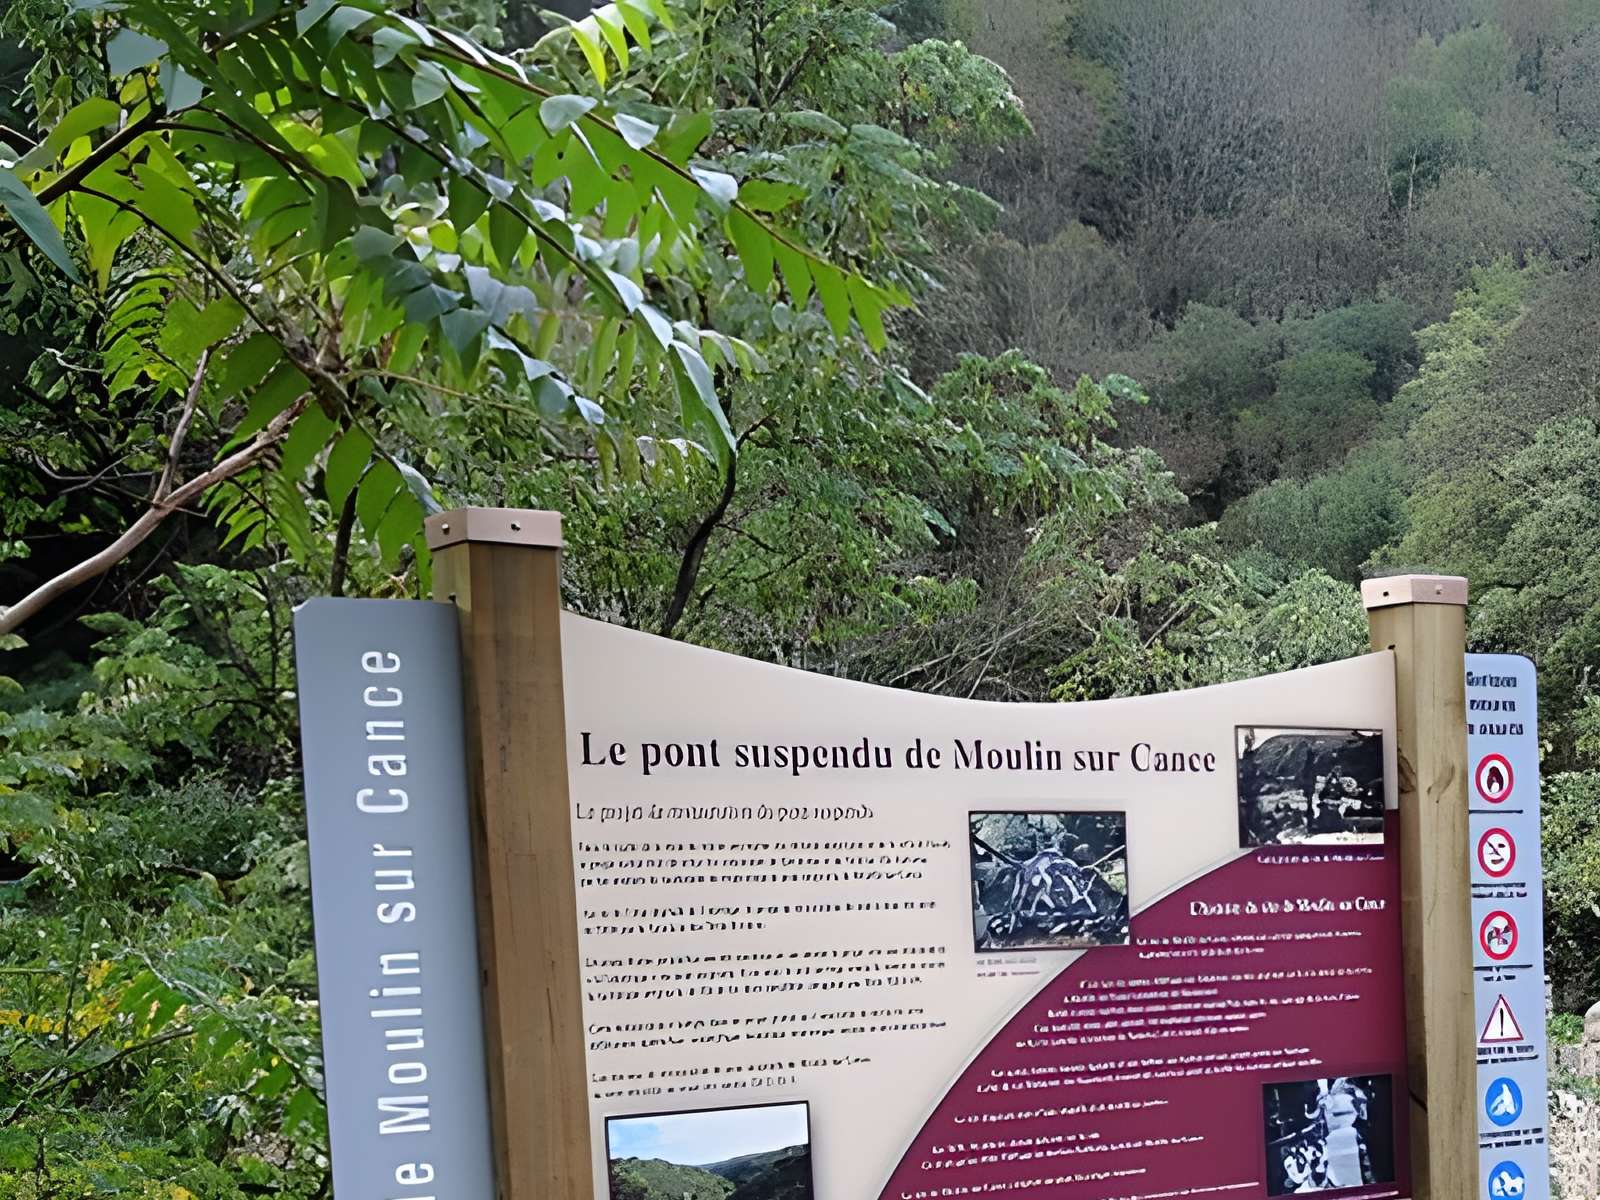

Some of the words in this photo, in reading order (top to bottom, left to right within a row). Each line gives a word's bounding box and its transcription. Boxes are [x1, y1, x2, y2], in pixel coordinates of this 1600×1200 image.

[356, 650, 409, 815] Cance
[580, 731, 626, 766] Le
[641, 738, 721, 776] pont
[734, 736, 892, 777] suspendu
[905, 737, 942, 769] de
[953, 738, 1062, 771] Moulin
[1073, 750, 1121, 772] sur
[1130, 742, 1217, 773] Cance
[372, 843, 416, 924] sur
[370, 951, 431, 1135] Moulin
